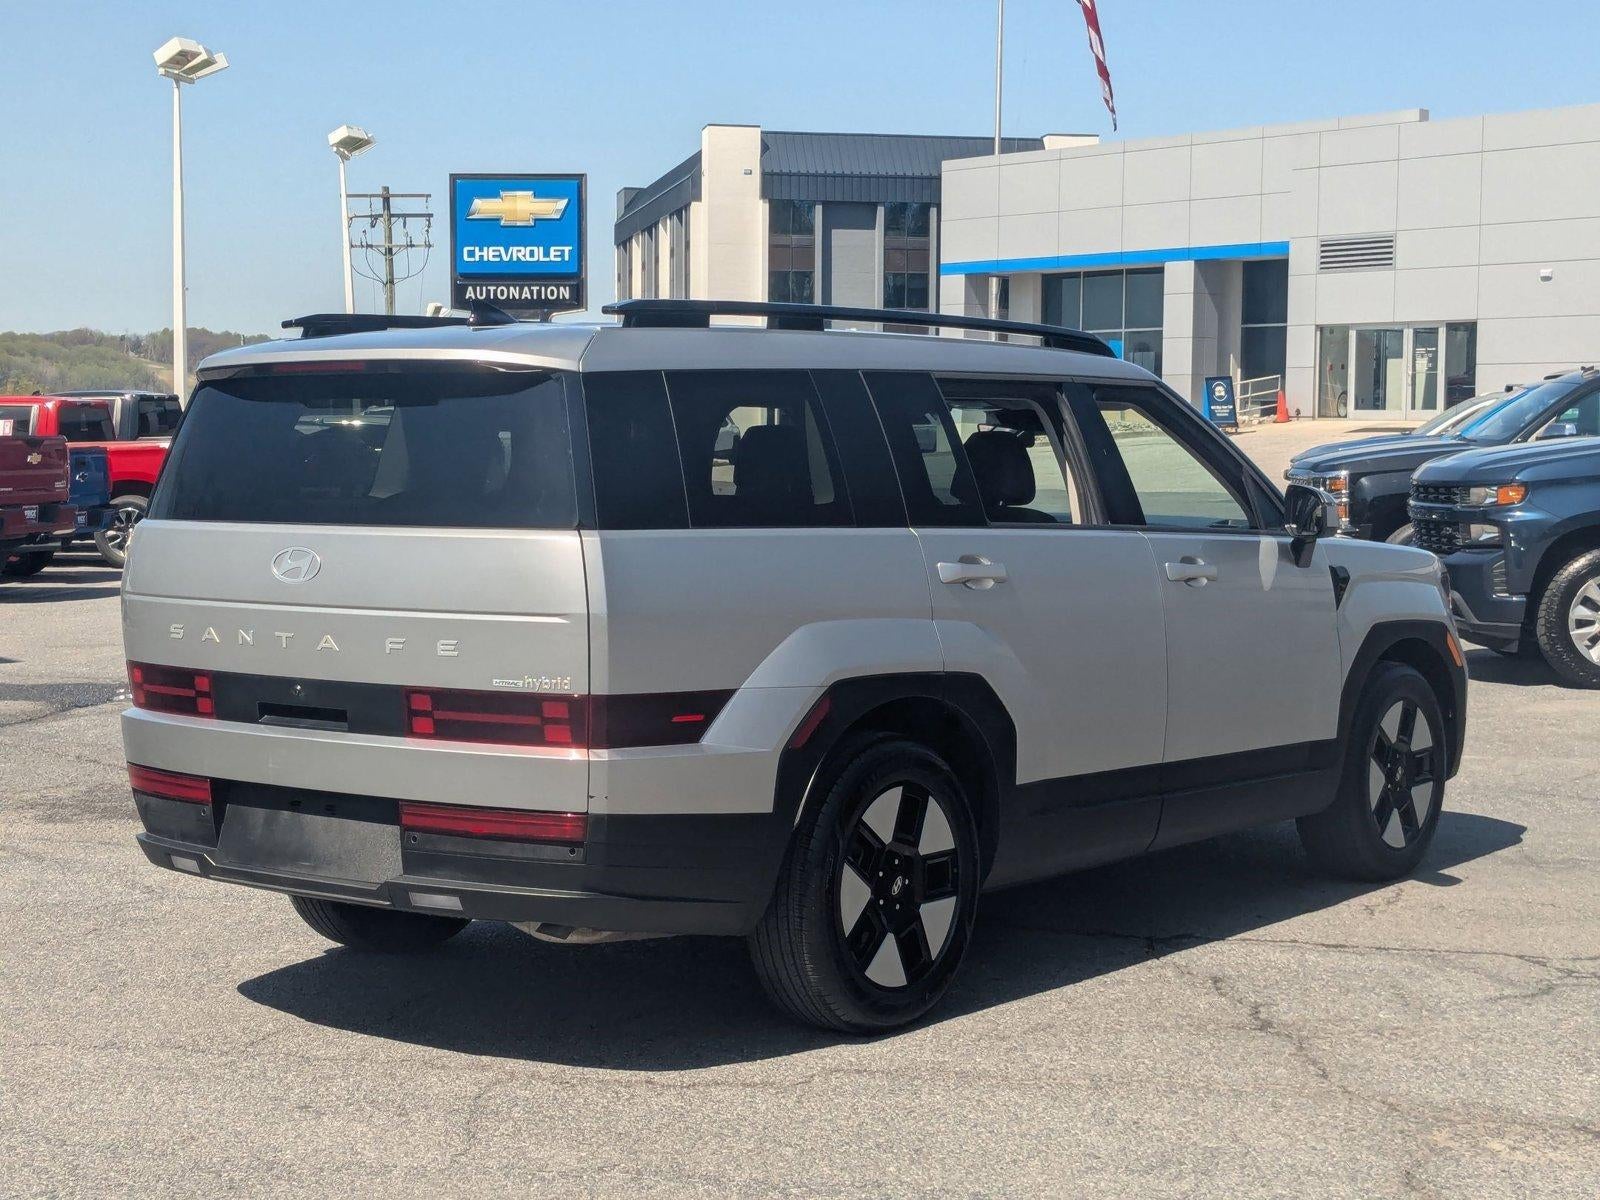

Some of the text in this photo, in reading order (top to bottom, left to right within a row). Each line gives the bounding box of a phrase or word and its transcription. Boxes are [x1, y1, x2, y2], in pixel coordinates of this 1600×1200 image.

[463, 246, 573, 262] CHEVROLET
[465, 286, 570, 300] AUTONATION
[169, 623, 459, 657] SANTA FE
[524, 675, 571, 691] hybrid
